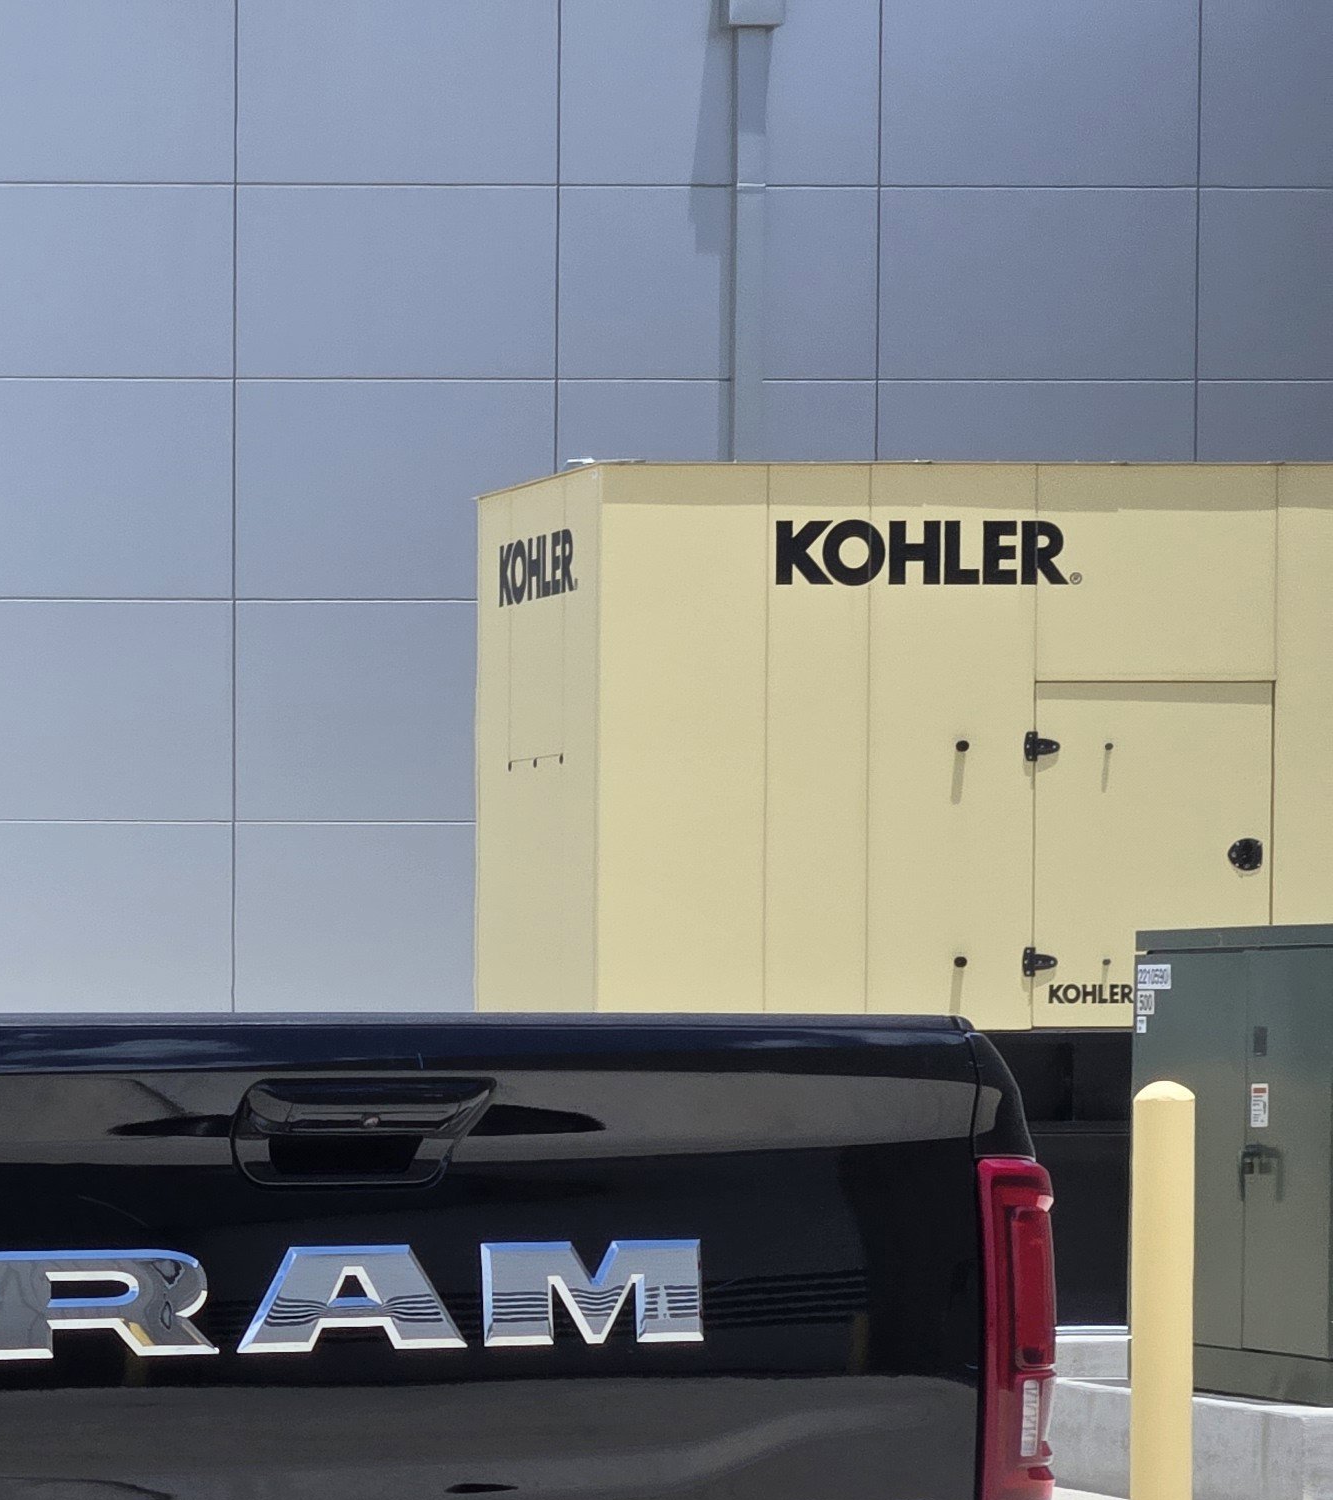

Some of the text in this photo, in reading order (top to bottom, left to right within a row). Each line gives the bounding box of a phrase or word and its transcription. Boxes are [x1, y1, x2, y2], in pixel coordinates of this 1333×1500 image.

[499, 529, 573, 608] KOHLER
[776, 519, 1069, 586] KOHLER
[1048, 984, 1133, 1004] KOHLER
